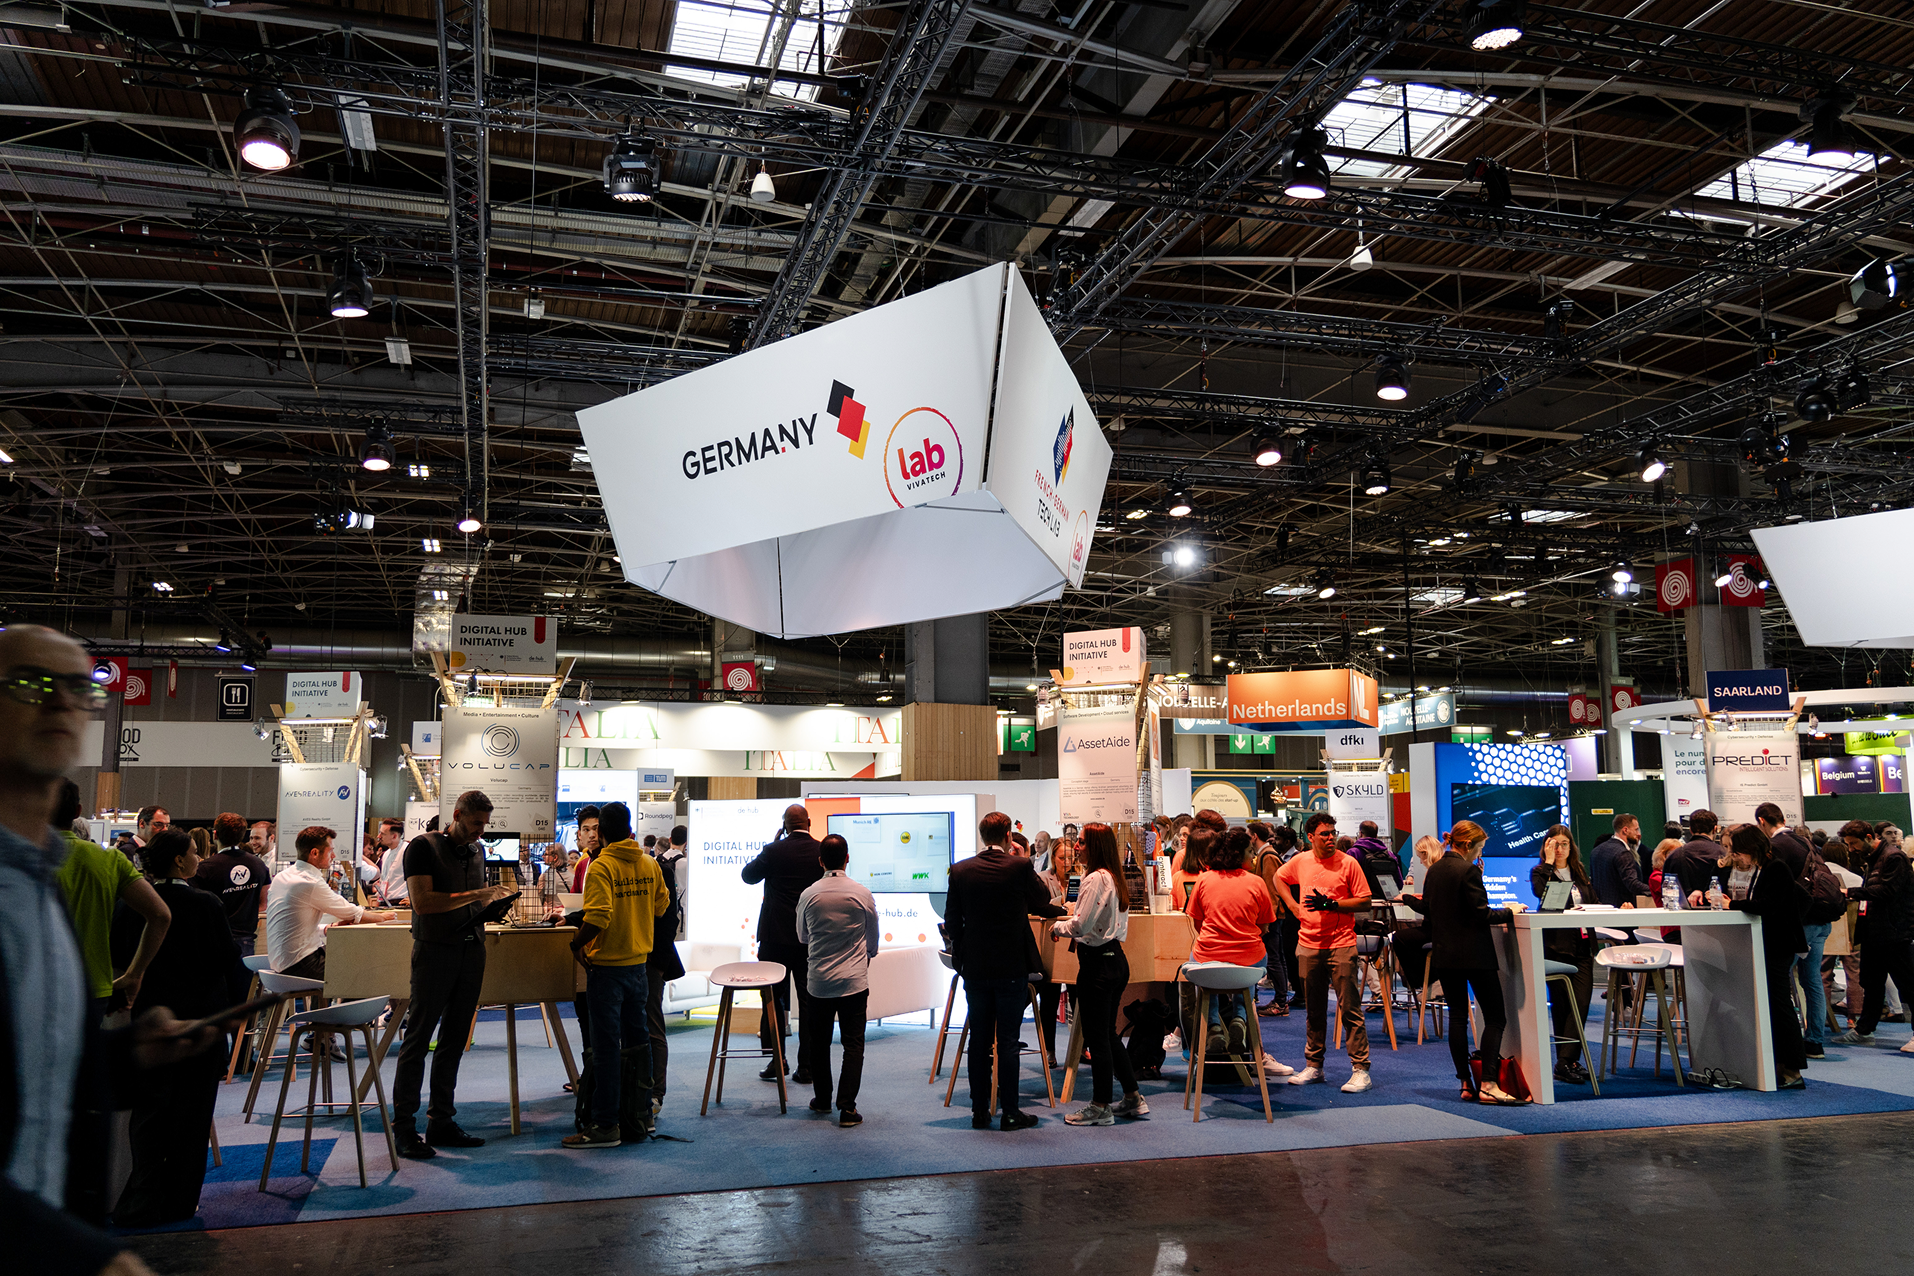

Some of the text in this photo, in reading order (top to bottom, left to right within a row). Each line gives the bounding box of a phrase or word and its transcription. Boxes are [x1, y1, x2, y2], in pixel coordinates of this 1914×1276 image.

[683, 412, 818, 480] GERMANY
[897, 437, 946, 480] lab
[906, 471, 946, 491] VIVATECH
[1073, 533, 1083, 562] lab
[460, 625, 527, 636] DIGITAL HUB
[460, 637, 515, 647] INITIATIVE
[1069, 638, 1117, 650] DIGITAL HUB
[1069, 651, 1108, 661] INITIATIVE
[1353, 675, 1370, 720] NL
[1714, 686, 1782, 697] SAARLAND
[1233, 698, 1346, 719] Netherlands
[272, 729, 308, 745] FD
[1078, 736, 1130, 750] AssetAide
[1340, 735, 1364, 746] dfki
[742, 750, 836, 771] ITALIA
[1822, 771, 1854, 781] Belgium
[1346, 784, 1384, 796] SKYLD
[1508, 829, 1549, 849] Health Car
[704, 842, 742, 850] DIGITAL
[1482, 875, 1517, 884] Germany's
